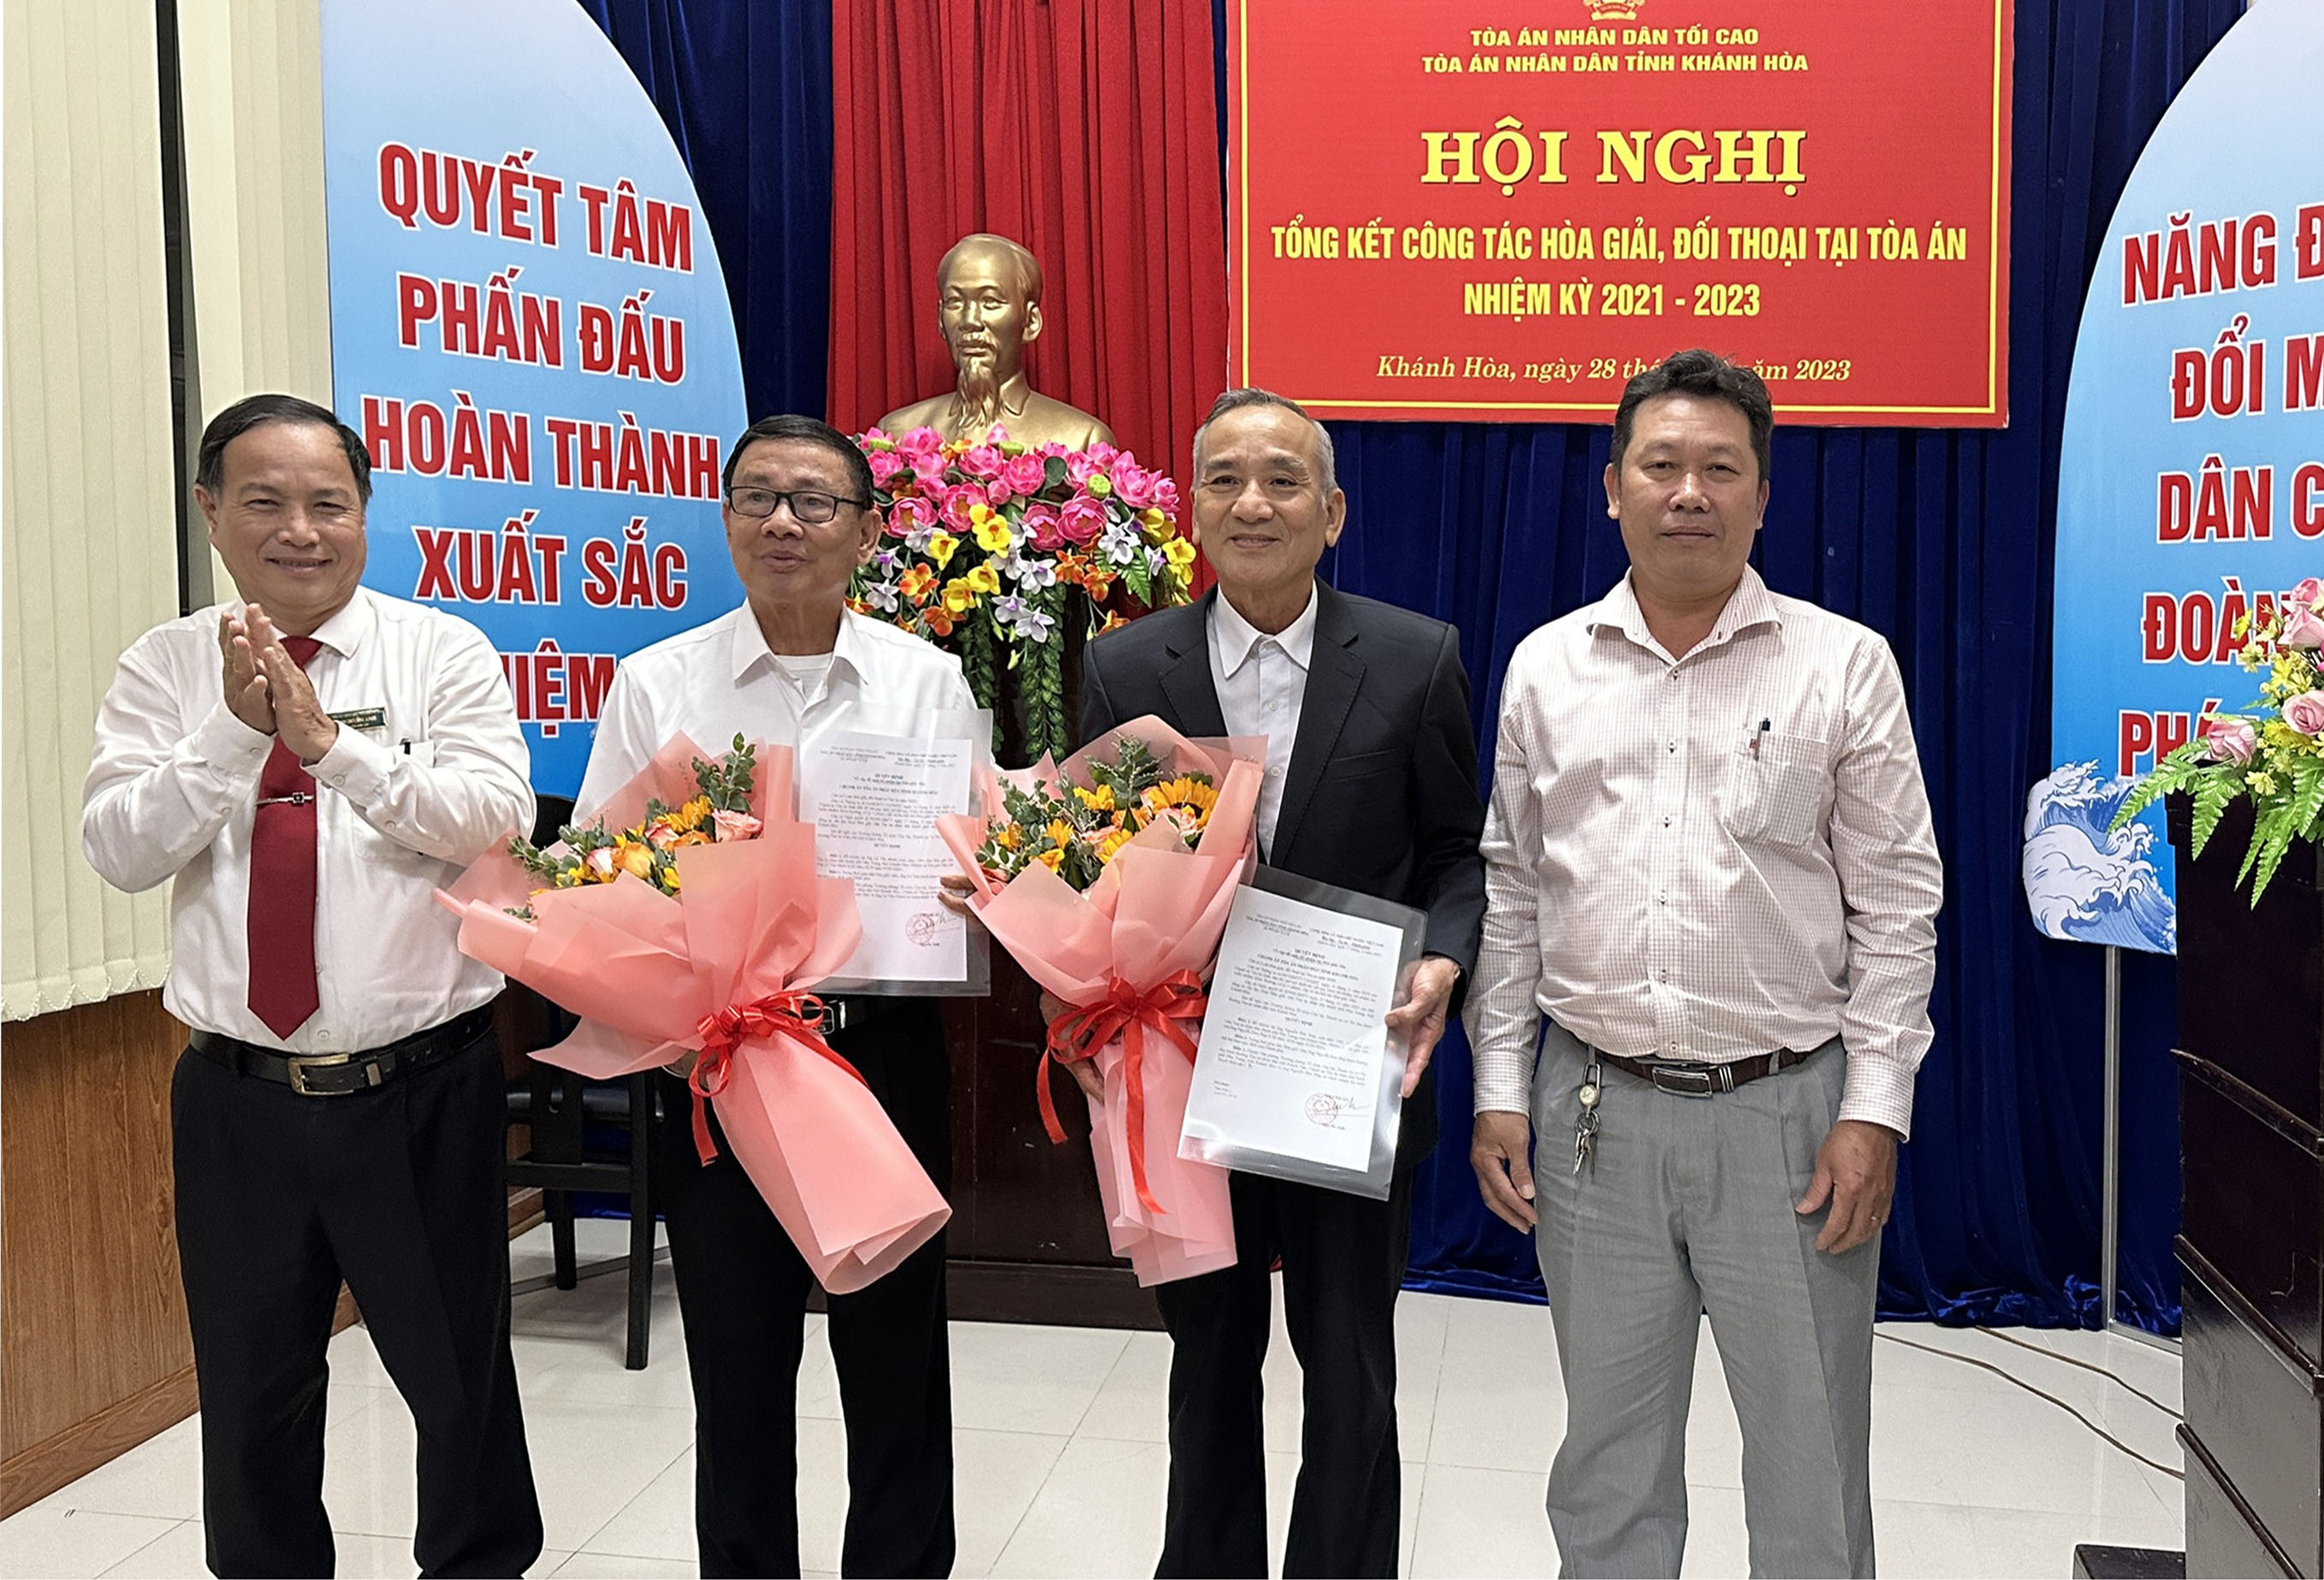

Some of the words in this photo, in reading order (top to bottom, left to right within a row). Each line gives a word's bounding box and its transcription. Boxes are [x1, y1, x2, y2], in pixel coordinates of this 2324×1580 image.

[1421, 53, 1463, 73] TÒA
[1468, 54, 1499, 73] ÁN
[1505, 53, 1567, 73] NHÂN
[1573, 52, 1619, 72] DÂN
[1625, 50, 1675, 72] TỈNH
[1681, 51, 1757, 71] KHÁNH
[1764, 51, 1808, 71] HÒA
[1470, 27, 1511, 47] TÒA
[1517, 27, 1548, 46] ÁN
[1555, 27, 1616, 45] NHÂN
[1622, 26, 1668, 45] DÂN
[1674, 23, 1709, 45] TỐI
[1716, 28, 1758, 44] CAO
[1420, 115, 1568, 196] HỘI
[1596, 129, 1806, 196] NGHỊ
[378, 143, 564, 248] QUYẾT
[578, 179, 694, 274] TÂM
[1271, 214, 1339, 259] TỔNG
[1348, 216, 1395, 259] KẾT
[1402, 221, 1474, 260] CÔNG
[1482, 221, 1533, 260] TÁC
[1540, 220, 1595, 260] HÒA
[1603, 216, 1665, 263] GIẢI,
[1673, 215, 1719, 260] ĐỐI
[1727, 227, 1807, 267] THOẠI
[1815, 227, 1858, 267] TẠI
[1866, 219, 1919, 260] TÒA
[1927, 221, 1966, 260] ÁN
[1464, 276, 1550, 323] NHIỆM
[1559, 276, 1593, 316] KỲ
[1601, 283, 1663, 316] 2021
[1693, 283, 1760, 317] 2023
[2123, 211, 2278, 306] NĂNG
[398, 267, 563, 369] PHẤN
[577, 291, 686, 386] ĐẤU
[1377, 356, 1455, 377] Khánh
[1463, 357, 1516, 381] Hòa,
[1524, 358, 1580, 383] ngày
[1587, 358, 1617, 379] 28
[1751, 358, 1788, 381] ăm
[1794, 359, 1852, 381] 2023
[2170, 314, 2265, 421] ĐỔI
[362, 392, 532, 485] HOÀN
[546, 410, 721, 502] THÀNH
[2157, 455, 2273, 543] DÂN
[415, 511, 567, 605] XUẤT
[583, 518, 688, 609] SẮC
[501, 639, 615, 737] IỆM
